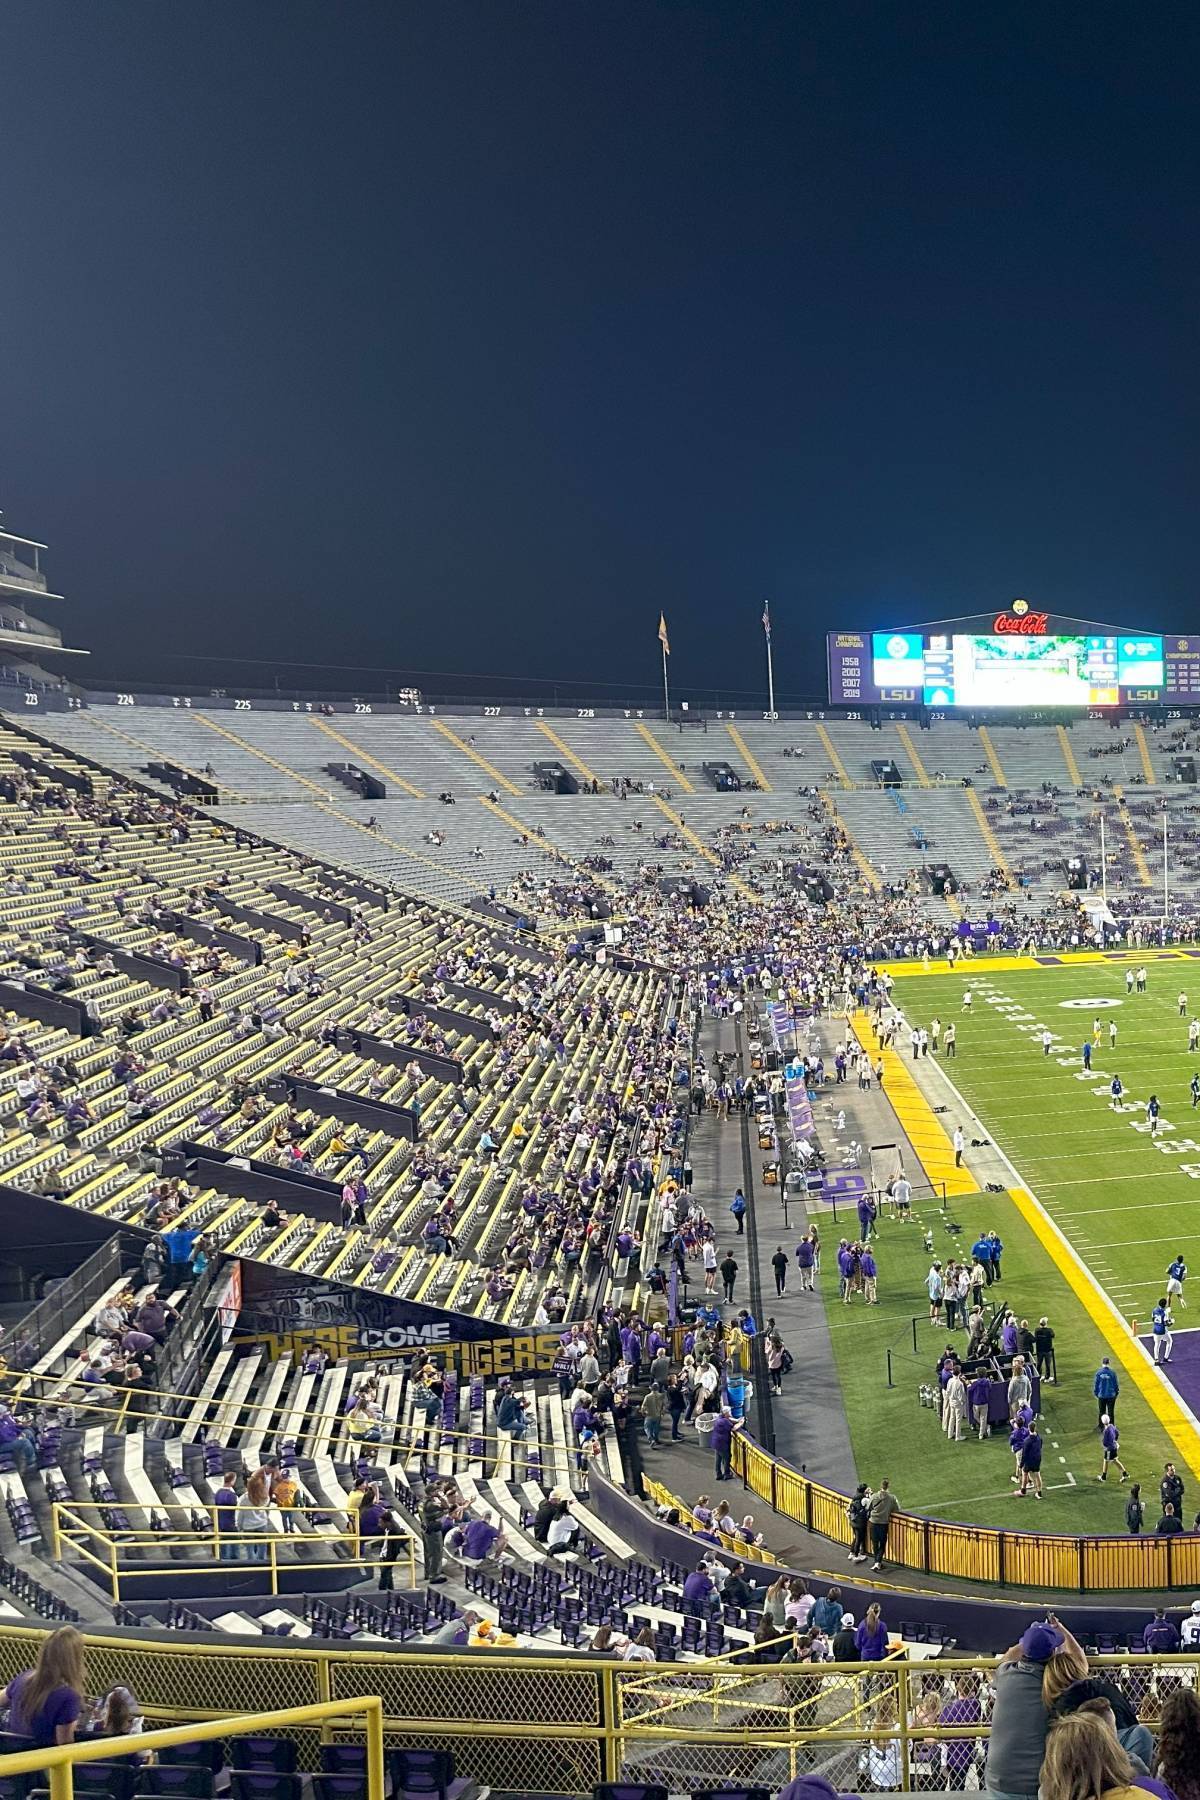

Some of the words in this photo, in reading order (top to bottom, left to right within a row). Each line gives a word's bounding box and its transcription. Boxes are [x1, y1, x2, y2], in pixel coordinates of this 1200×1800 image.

[842, 657, 859, 665] 1958
[842, 668, 860, 676] 2003
[842, 678, 860, 687] 2007
[843, 689, 860, 698] 2019
[881, 689, 915, 701] LSU
[1127, 689, 1159, 701] LSU
[25, 693, 38, 705] 223
[118, 694, 134, 705] 224
[235, 700, 251, 710] 225
[355, 703, 372, 713] 226
[484, 707, 501, 716] 227
[578, 709, 595, 718] 228
[847, 711, 861, 720] 231
[931, 712, 945, 720] 232
[1089, 711, 1103, 720] 234
[1167, 710, 1181, 719] 235
[361, 1322, 450, 1348] COME
[440, 1333, 561, 1377] TIGERS
[1190, 1627, 1200, 1642] 9
